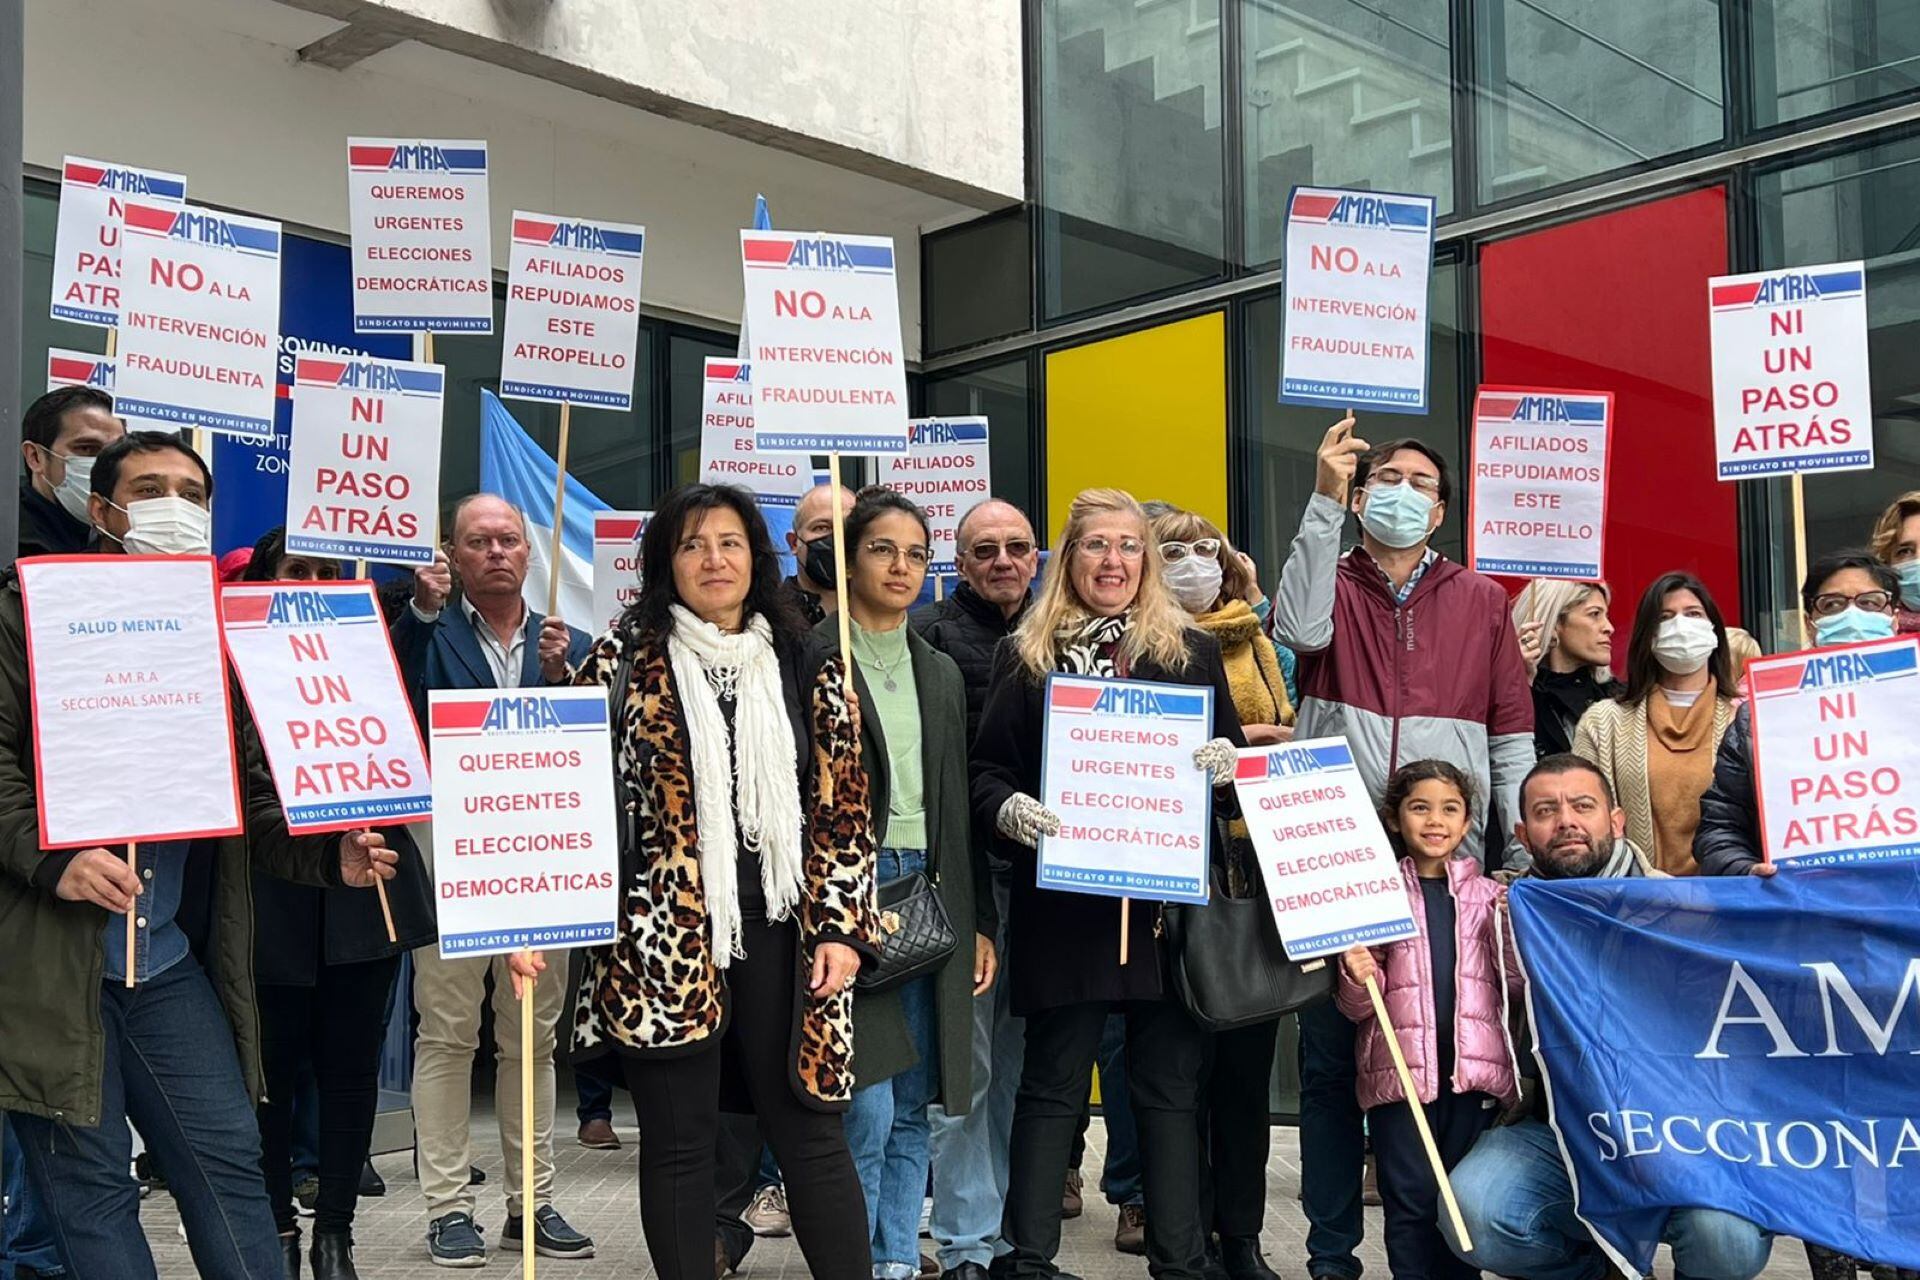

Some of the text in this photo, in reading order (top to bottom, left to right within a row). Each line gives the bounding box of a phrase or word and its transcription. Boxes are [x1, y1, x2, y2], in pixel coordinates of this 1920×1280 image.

[389, 145, 450, 170] AMRA
[97, 168, 151, 195] AMRA
[371, 185, 465, 201] QUEREMOS
[109, 197, 122, 217] N
[1328, 195, 1390, 226] AMRA
[100, 225, 117, 247] U
[168, 211, 237, 248] AMRA
[375, 216, 464, 231] URGENTES
[549, 222, 606, 251] AMRA
[78, 252, 121, 278] PA
[368, 247, 472, 261] ELECCIONES
[788, 239, 854, 268] AMRA
[1311, 245, 1401, 278] NO A LA
[150, 258, 250, 301] NO A LA
[526, 258, 624, 283] AFILIADOS
[65, 282, 120, 308] ATR
[357, 276, 488, 293] DEMOCRÁTICAS
[1754, 274, 1820, 305] AMRA
[511, 285, 635, 313] REPUDIAMOS
[775, 290, 872, 320] NO A LA
[1292, 297, 1416, 321] INTERVENCIÓN
[127, 312, 266, 348] INTERVENCIÓN
[358, 319, 410, 327] SINDICATO
[428, 320, 488, 329] MOVIMIENTO
[548, 318, 595, 337] ESTE
[1771, 309, 1803, 336] NI
[514, 343, 625, 368] ATROPELLO
[760, 347, 893, 365] INTERVENCIÓN
[1291, 336, 1414, 360] FRAUDULENTA
[1764, 345, 1812, 374] UN
[87, 361, 116, 385] AM
[126, 353, 264, 389] FRAUDULENTA
[337, 361, 401, 391] AMRA
[504, 385, 628, 404] SINDICATO EN MOVIMIENTO
[716, 392, 752, 405] AFILI
[762, 388, 896, 405] FRAUDULENTA
[1286, 382, 1419, 400] SINDICATO EN MOVIMIENTO
[1742, 381, 1839, 414] PASO
[118, 402, 268, 431] SINDICATO EN MOVIMIENTO
[352, 396, 384, 423] NI
[706, 414, 754, 428] REPUD
[1512, 397, 1570, 422] AMRA
[734, 438, 754, 450] ES
[760, 438, 817, 447] SINDICATO
[821, 439, 833, 447] EN
[838, 440, 904, 448] MOVIMIENTO
[910, 423, 957, 444] AMRA
[1490, 436, 1588, 453] AFILIADOS
[1732, 414, 1852, 453] ATRÁS
[342, 433, 389, 461] UN
[256, 455, 290, 474] ZON
[709, 460, 797, 476] ATROPELLO
[893, 455, 975, 470] AFILIADOS
[1477, 463, 1600, 482] REPUDIAMOS
[1722, 454, 1868, 474] SINDICATO EN MOVIMIENTO
[317, 468, 410, 500] PASO
[926, 505, 955, 517] STE
[1514, 493, 1561, 509] ESTE
[302, 505, 418, 539] ATRÁS
[1483, 520, 1592, 539] ATROPELLO
[290, 540, 430, 559] SINDICATO EN MOVIMIENTO
[1477, 561, 1523, 572] SINDICATO
[1539, 566, 1597, 575] MOVIMIENTO
[267, 592, 337, 624] AMRA
[68, 619, 182, 635] SALUD MENTAL
[289, 633, 330, 662] NI
[1800, 653, 1874, 689] AMRA
[61, 692, 201, 711] SECCIONAL SANTA FE
[296, 675, 352, 705] UN
[1093, 686, 1163, 715] AMRA
[481, 696, 561, 730] AMRA
[1819, 691, 1856, 722] NI
[286, 716, 387, 749] PASO
[1070, 727, 1179, 746] QUEREMOS
[1814, 730, 1869, 762] UN
[460, 751, 581, 772] QUEREMOS
[1072, 760, 1175, 780] URGENTES
[1267, 748, 1322, 778] AMRA
[294, 753, 412, 796] ATRÁS
[1790, 767, 1900, 805] PASO
[464, 792, 581, 813] URGENTES
[1061, 791, 1183, 814] ELECCIONES
[1259, 785, 1346, 811] QUEREMOS
[288, 801, 433, 821] SINDICATO EN MOVIMIENTO
[1060, 825, 1200, 850] EMOCRÁTICAS
[1273, 817, 1357, 842] URGENTES
[1783, 803, 1919, 849] ATRÁS
[455, 832, 593, 856] ELECCIONES
[1839, 854, 1854, 862] EN
[1858, 848, 1920, 860] MOVIMIEN
[1277, 847, 1376, 876] ELECCIONES
[441, 872, 612, 899] DEMOCRÁTICAS
[1044, 868, 1199, 890] SINDICATO EN MOVIMIENTO
[1275, 876, 1400, 912] DEMOCRÁTICAS
[445, 927, 612, 949] SINDICATO EN MOVIMIENTO
[1289, 922, 1413, 953] SINDICATO EN MOVIMIENTO
[1694, 958, 1920, 1059] AM
[1587, 1109, 1920, 1171] SECCIONA
